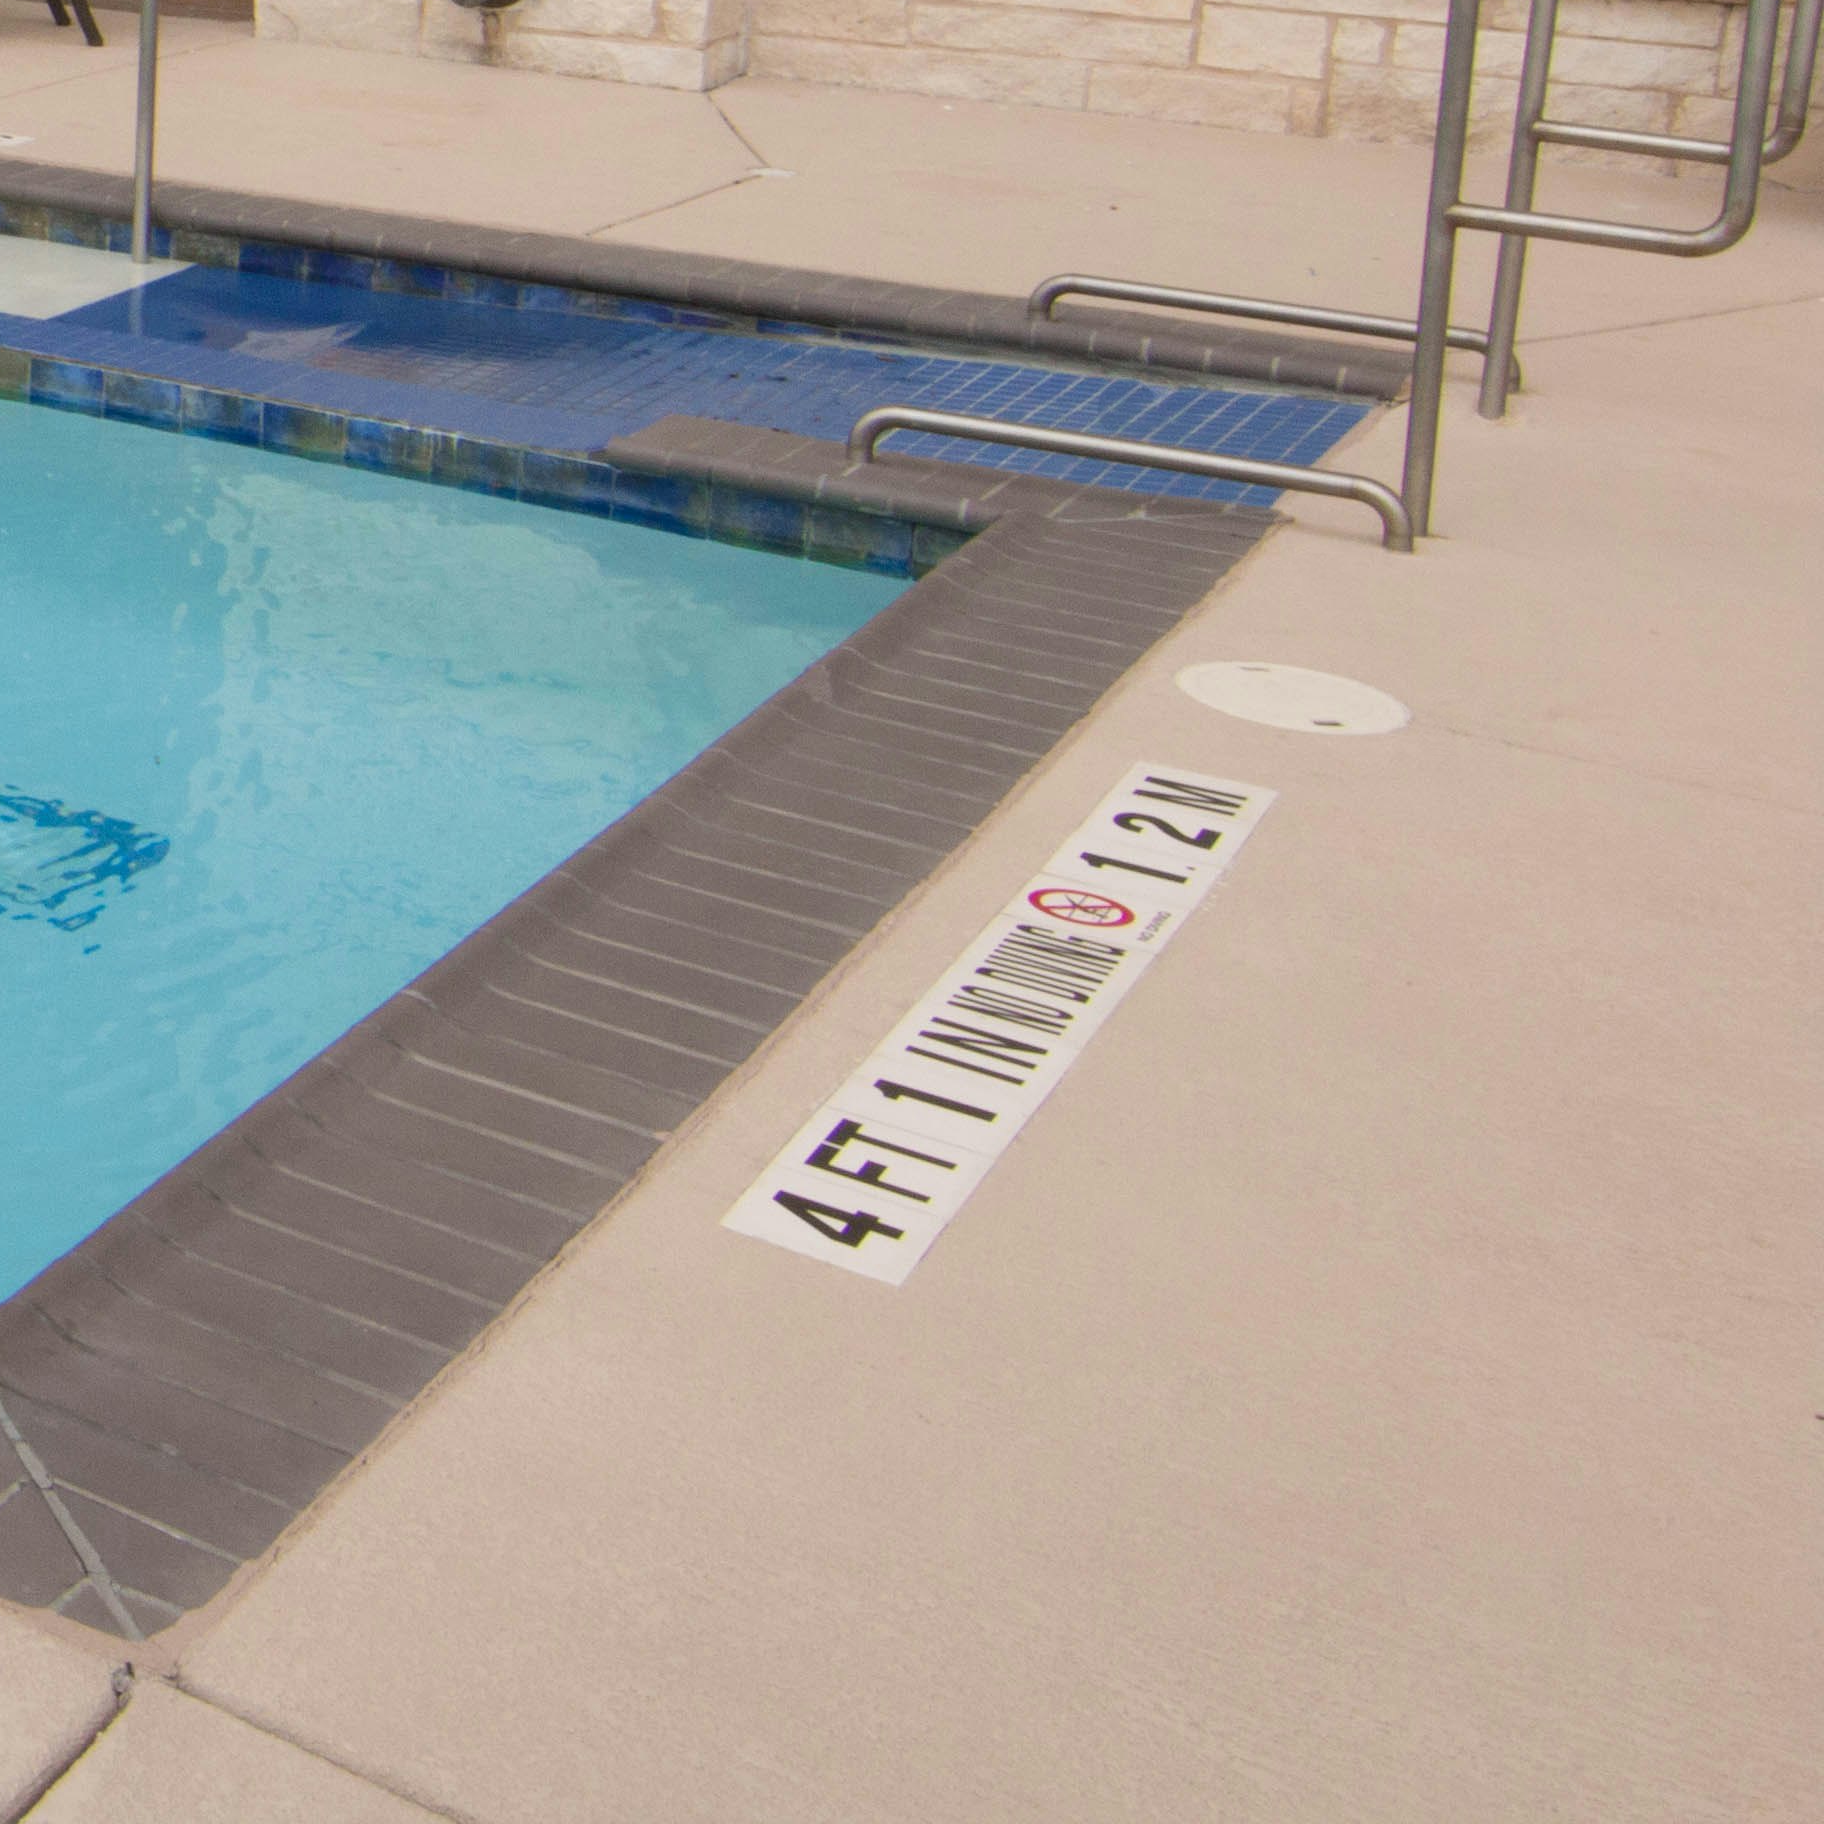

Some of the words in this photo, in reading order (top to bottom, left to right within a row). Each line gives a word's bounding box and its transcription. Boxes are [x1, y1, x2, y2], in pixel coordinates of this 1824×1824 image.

[1132, 776, 1249, 816] M
[975, 924, 1127, 1003] DIVING
[947, 985, 1074, 1036] NO
[905, 1016, 1049, 1087] IN
[872, 1078, 997, 1123] 1
[804, 1118, 958, 1203] FT
[773, 1189, 905, 1248] 4
